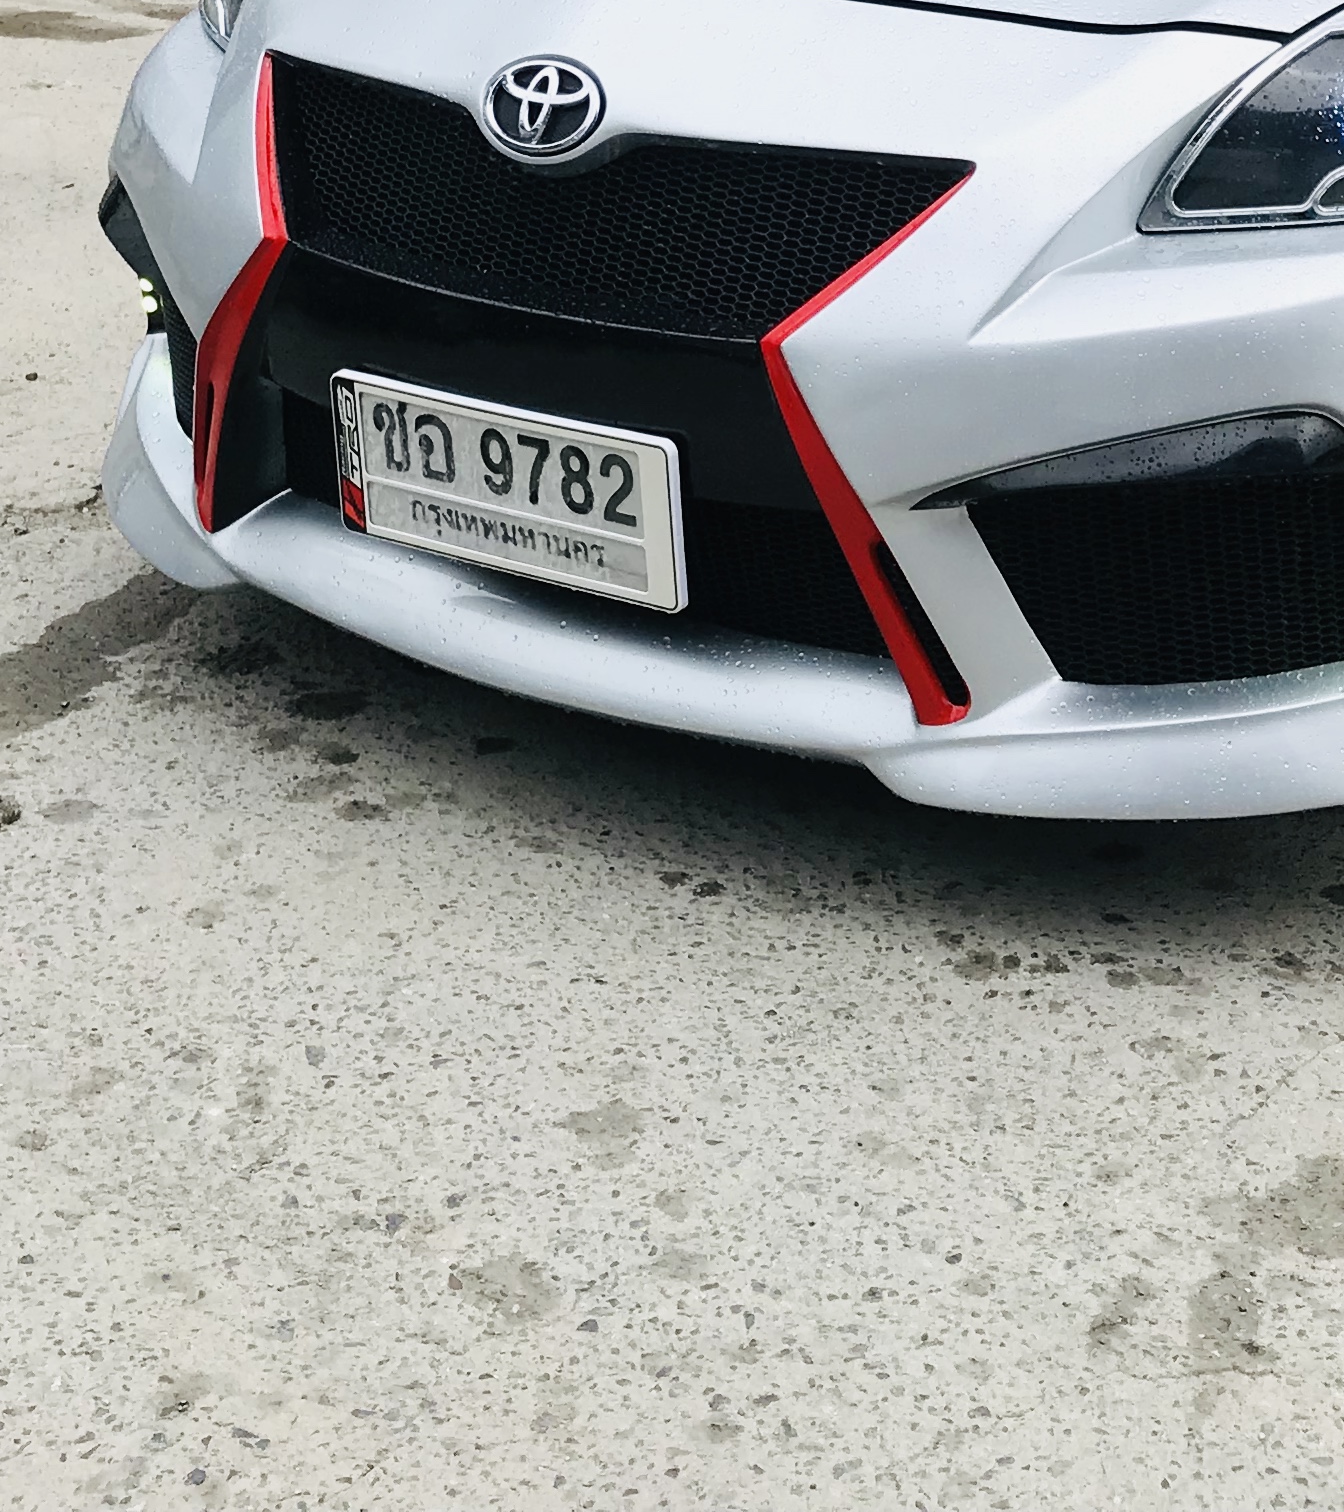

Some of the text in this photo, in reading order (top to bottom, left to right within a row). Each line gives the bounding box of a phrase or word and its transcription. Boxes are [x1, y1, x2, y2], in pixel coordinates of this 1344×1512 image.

[372, 401, 456, 484] ชอ
[479, 427, 638, 528] 9782
[411, 499, 606, 568] กรุงเทพมหานคร
